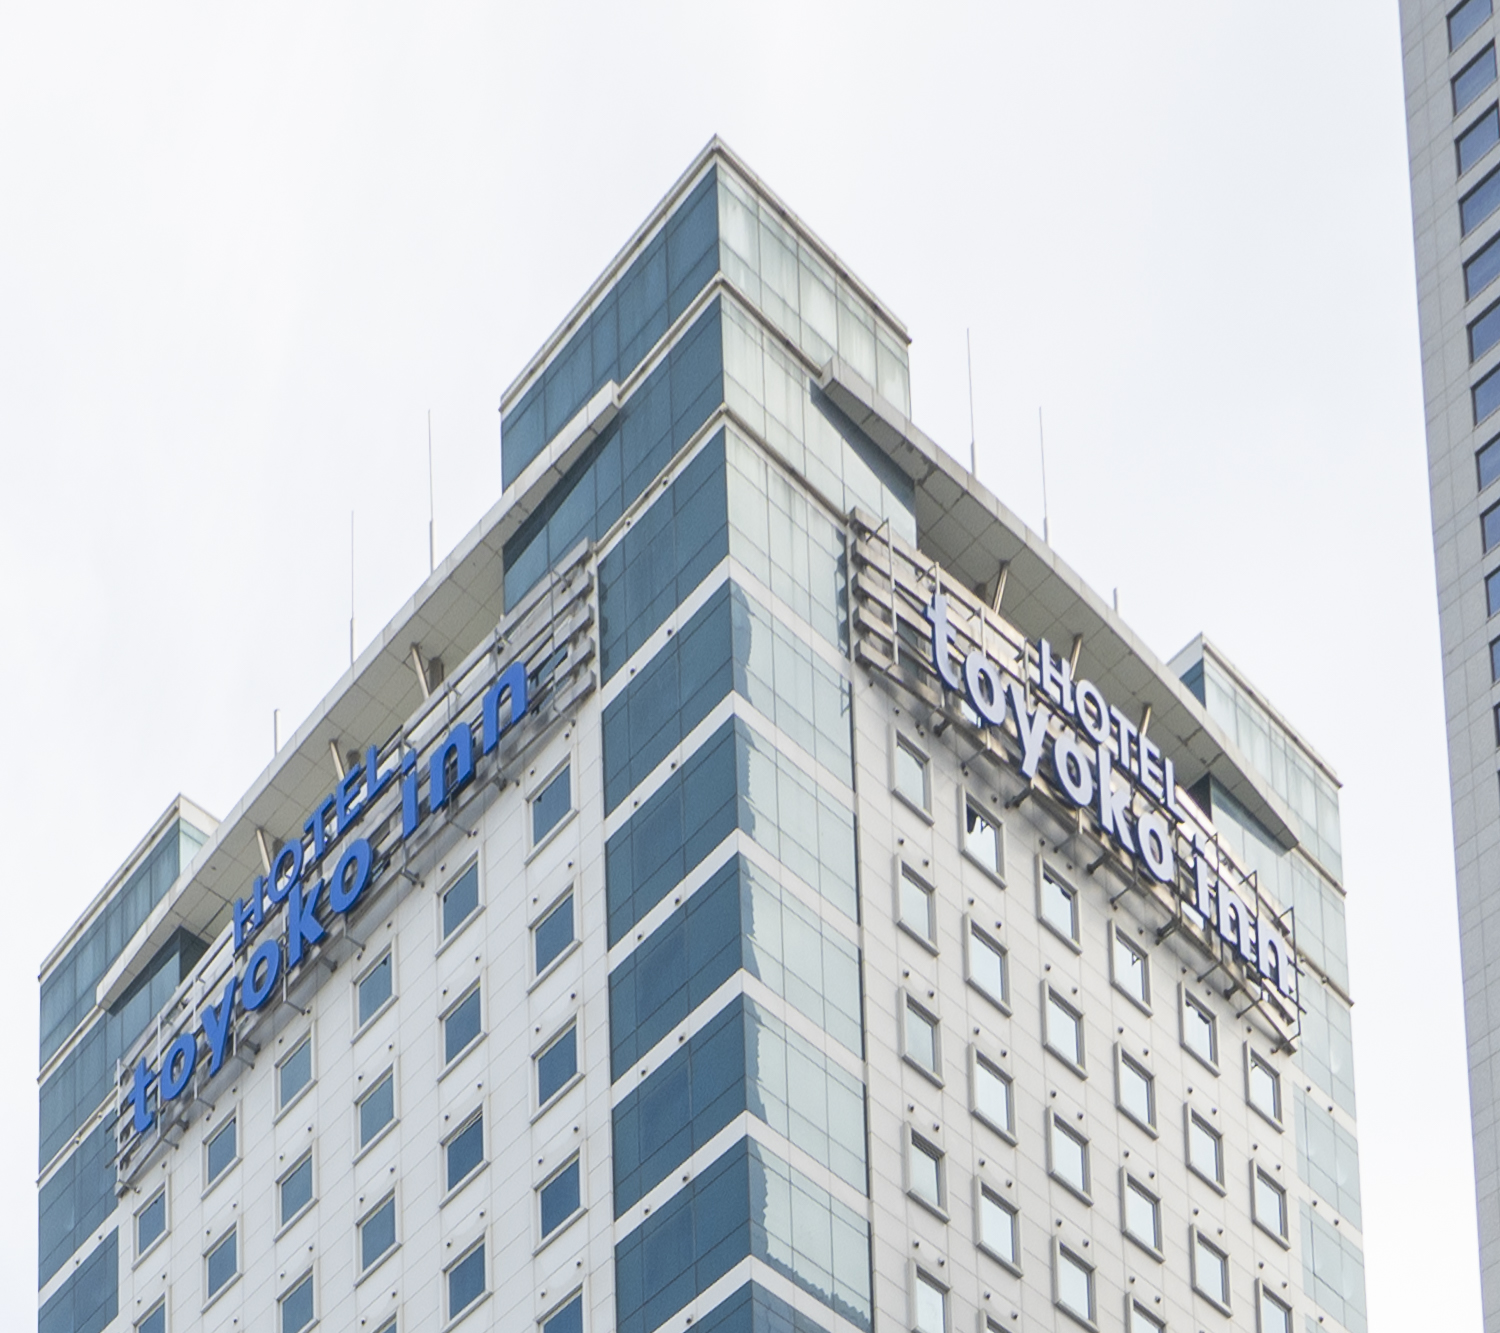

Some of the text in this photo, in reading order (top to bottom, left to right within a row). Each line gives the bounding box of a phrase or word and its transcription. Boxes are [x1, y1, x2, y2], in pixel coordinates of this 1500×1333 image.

[233, 743, 392, 956] HOTEL
[924, 593, 1297, 997] toyoko inn
[1036, 638, 1186, 823] HOTEL
[126, 660, 529, 1133] toyoko inn
